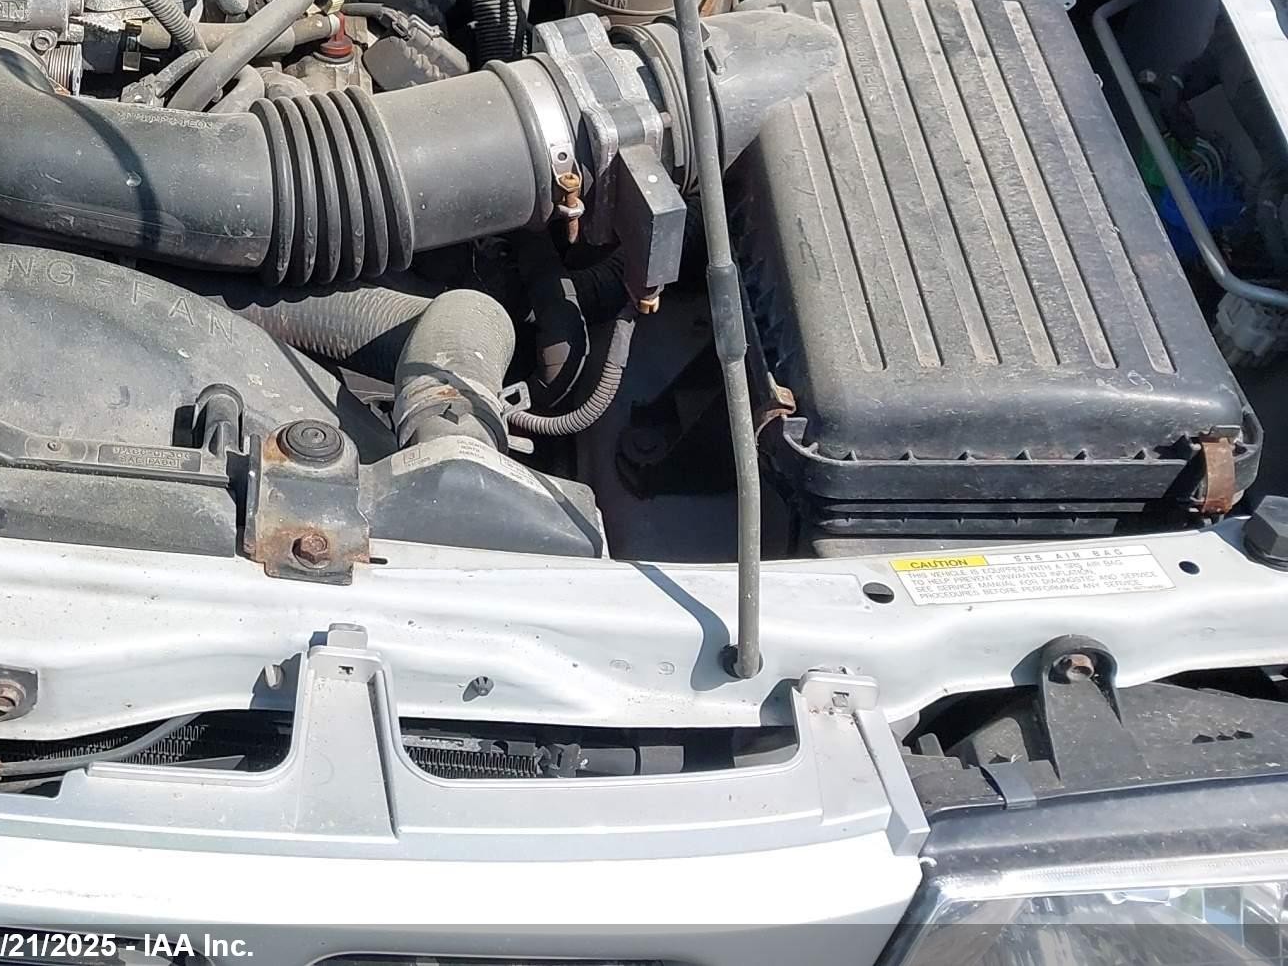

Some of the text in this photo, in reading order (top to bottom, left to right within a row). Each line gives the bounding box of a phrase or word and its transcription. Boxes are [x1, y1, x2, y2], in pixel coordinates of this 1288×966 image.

[131, 279, 235, 345] FAN
[909, 548, 1124, 569] CAUTION SRS AIR BAG
[928, 576, 950, 585] HELP
[953, 574, 993, 584] PREVENT
[995, 571, 1047, 581] UNWANTED
[931, 569, 966, 577] VEHICLE
[981, 565, 1025, 574] EQUIPPED
[1027, 564, 1052, 572] WITH
[919, 590, 980, 599] PROCEDURES
[982, 587, 1019, 595] BEFORE
[1021, 583, 1080, 593] PERFORMING
[936, 583, 973, 591] SERVICE
[977, 581, 1016, 589] MANUAL
[1041, 576, 1095, 585] DIAGNOSTIC
